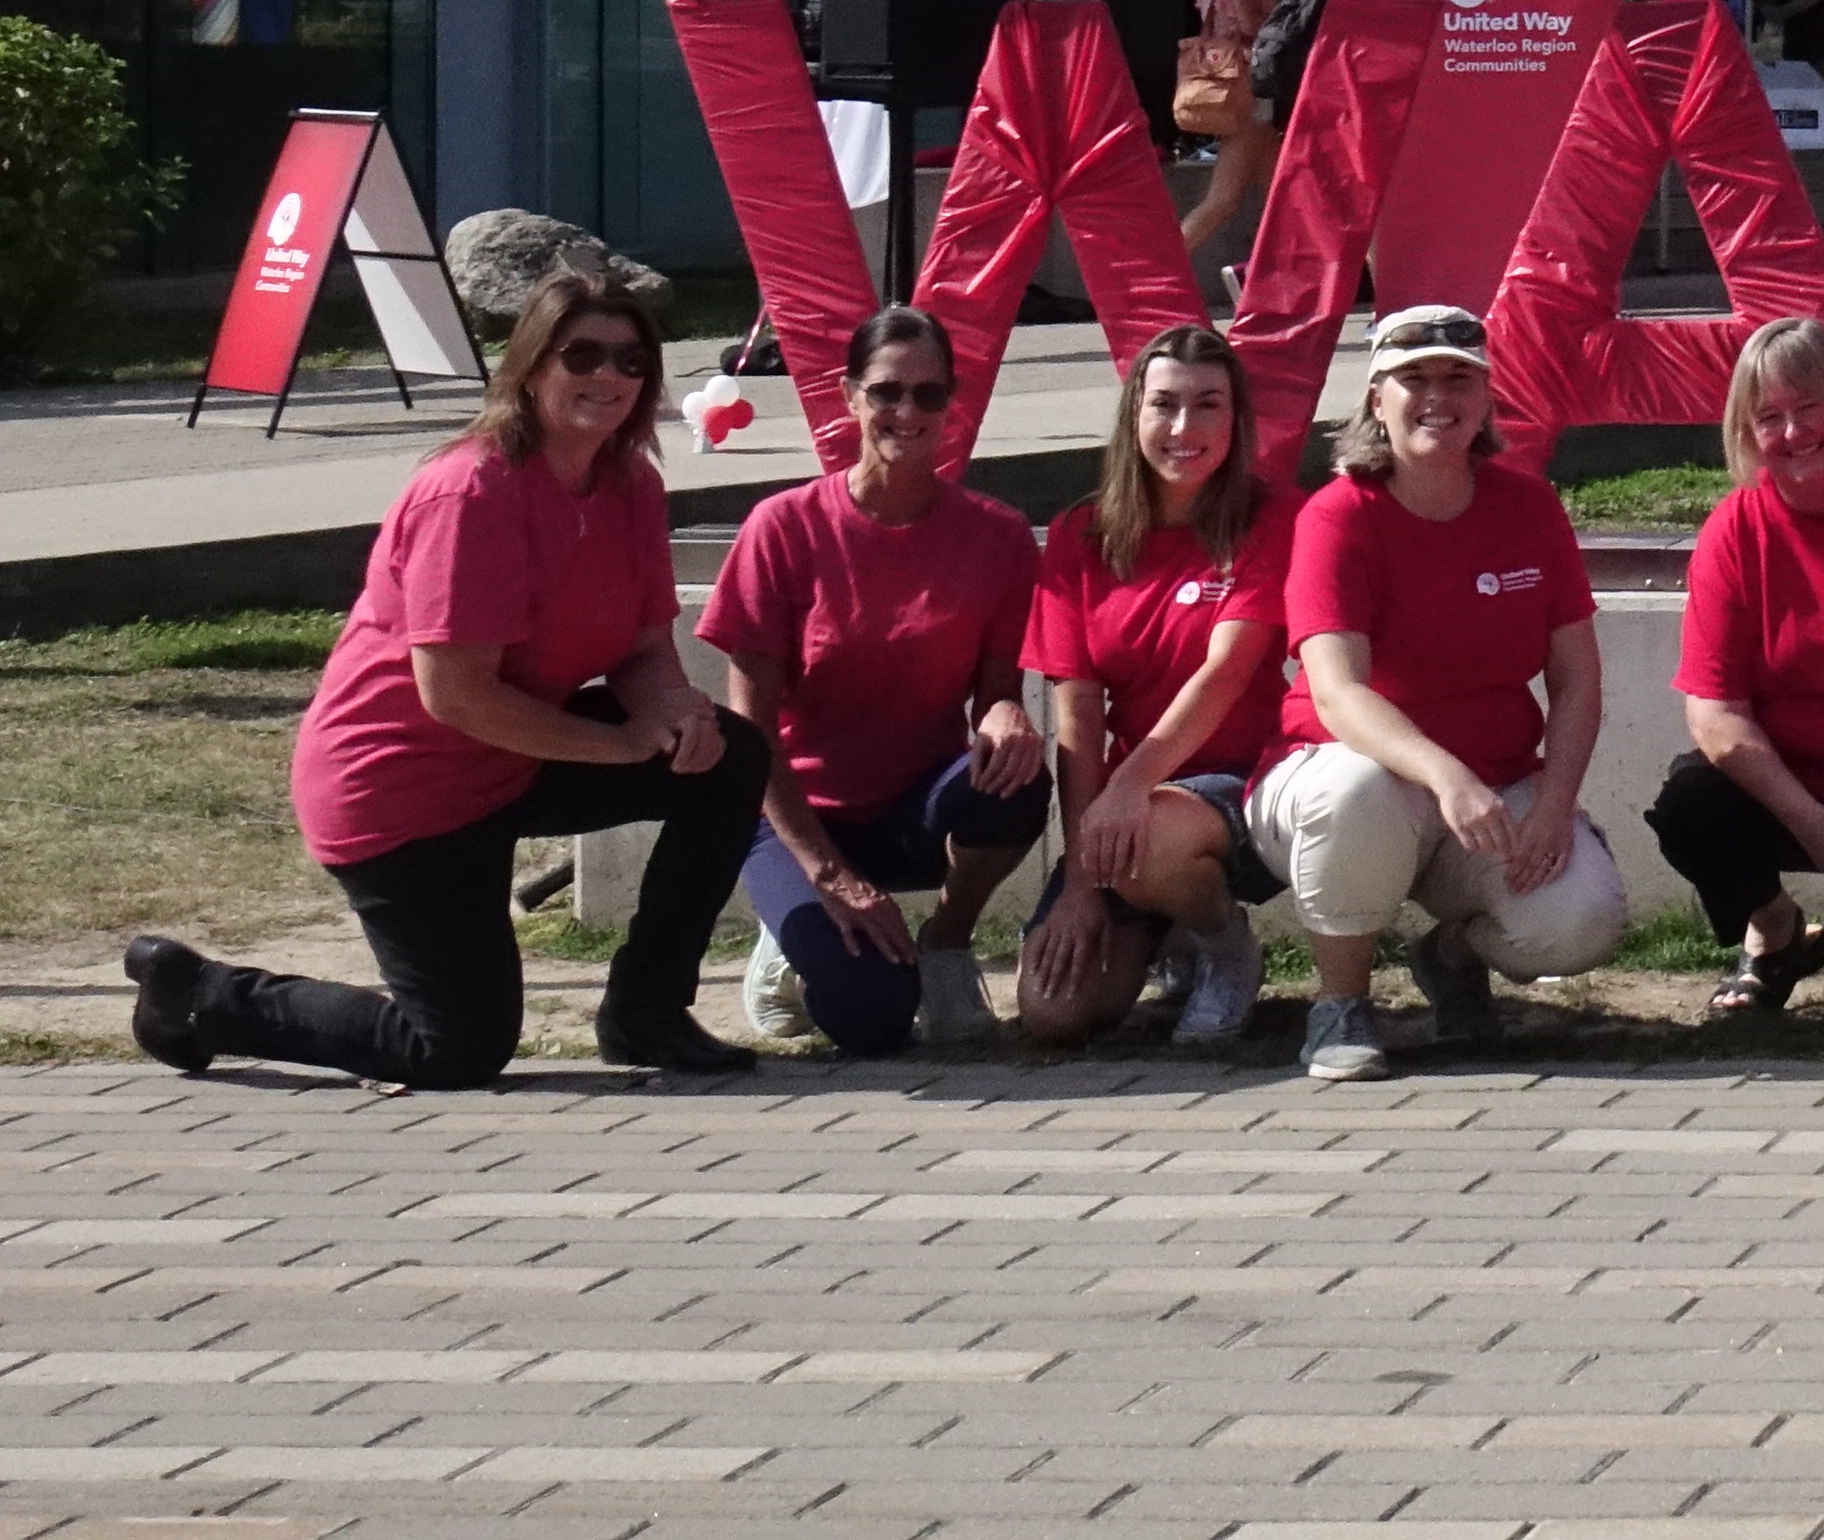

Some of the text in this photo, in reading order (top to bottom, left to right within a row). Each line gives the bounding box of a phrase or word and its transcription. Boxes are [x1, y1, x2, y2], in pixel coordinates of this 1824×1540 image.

[1443, 12, 1572, 36] United Way
[1445, 39, 1576, 55] Waterloo Region
[1444, 58, 1546, 72] Communities
